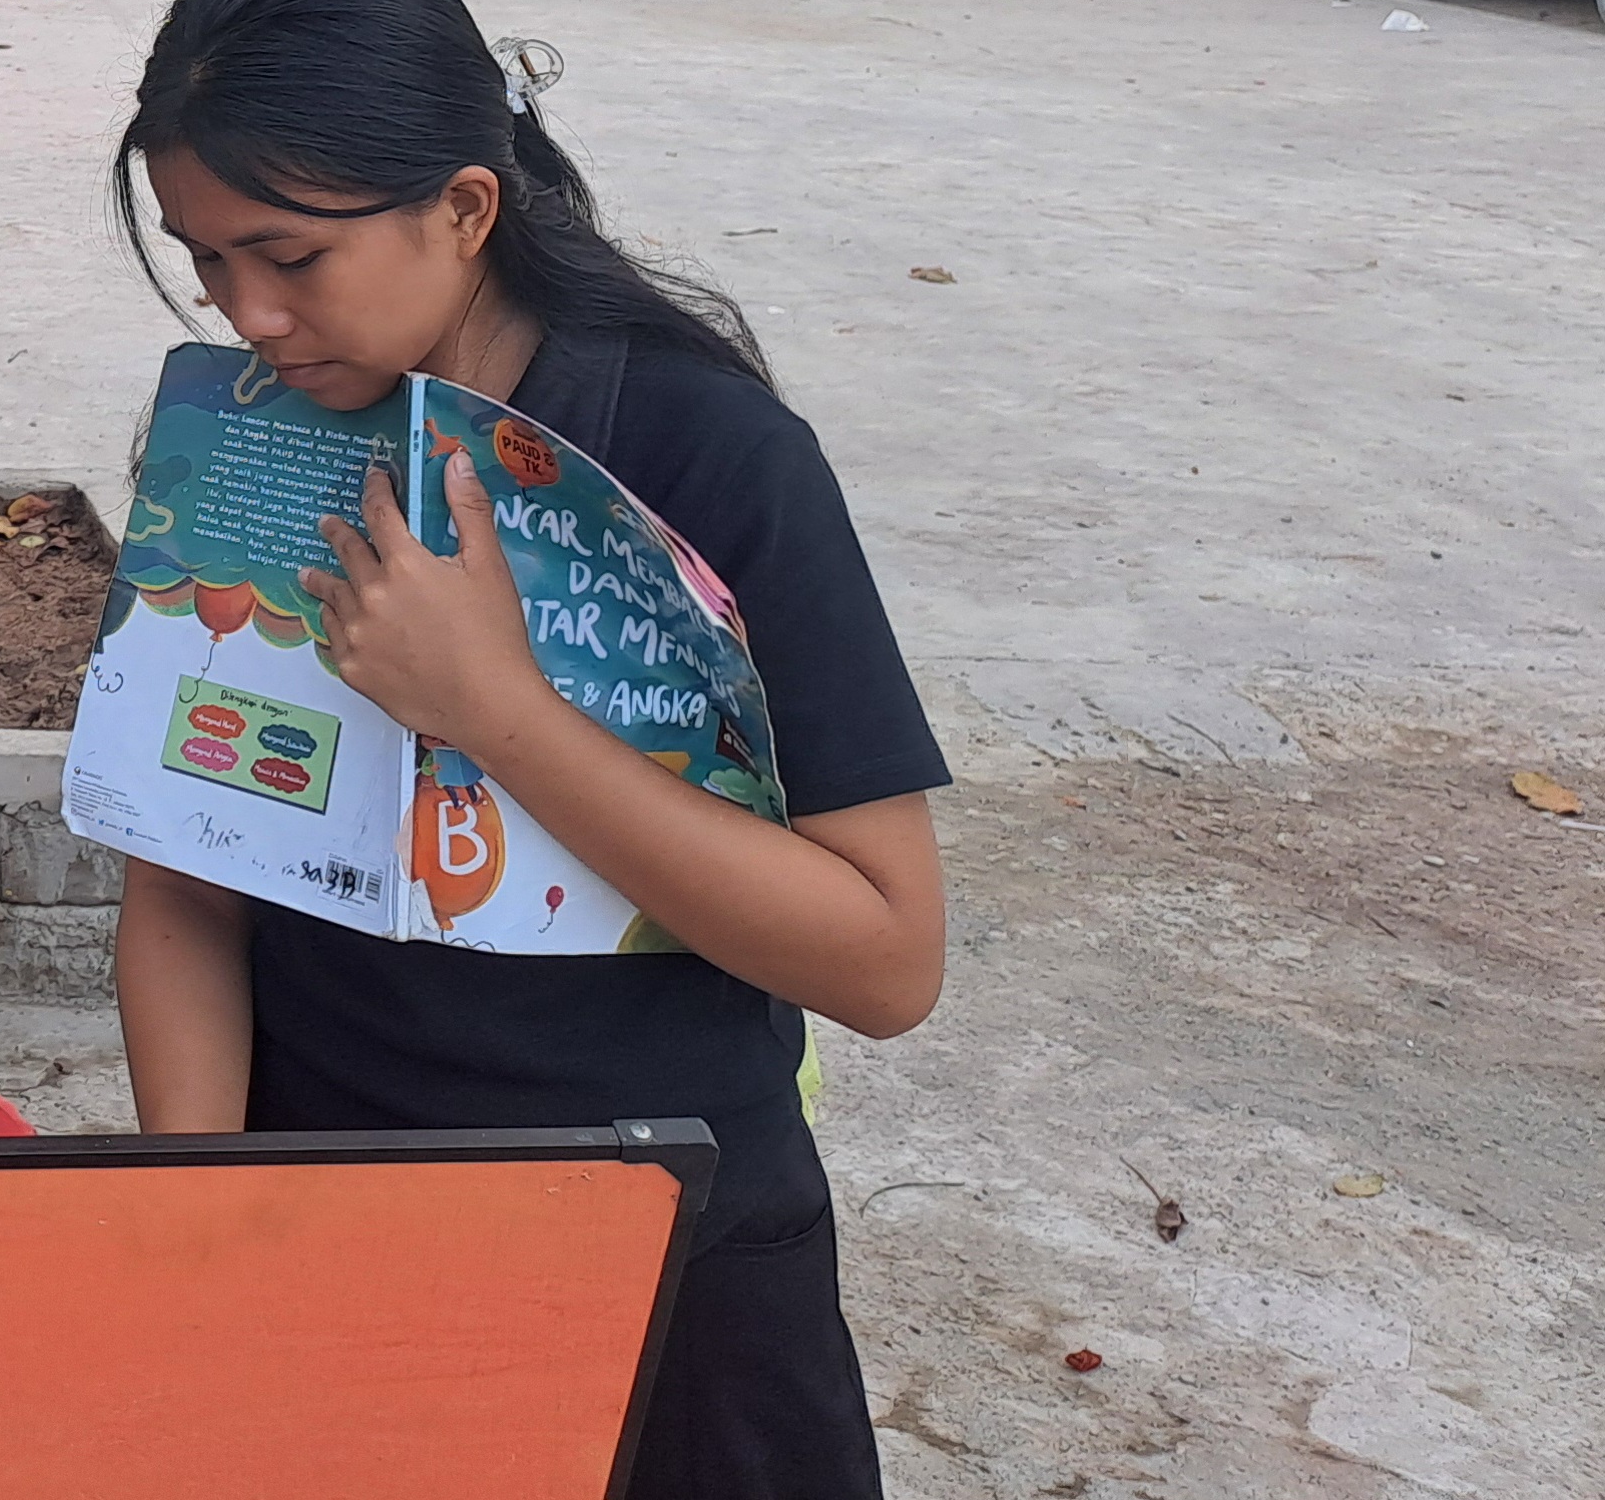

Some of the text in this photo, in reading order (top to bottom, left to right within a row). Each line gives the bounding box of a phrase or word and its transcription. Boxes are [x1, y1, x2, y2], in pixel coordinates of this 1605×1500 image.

[271, 447, 294, 459] PAUD
[502, 435, 541, 461] PAUD
[522, 457, 543, 476] TK
[209, 463, 230, 475] yang
[195, 501, 215, 513] yang
[448, 495, 726, 653] NCAR MEMBACA
[569, 560, 657, 615] DAN
[521, 597, 741, 718] TAR MENULIS
[583, 681, 601, 707] &
[606, 680, 708, 729] ANGKA
[438, 800, 488, 875] B
